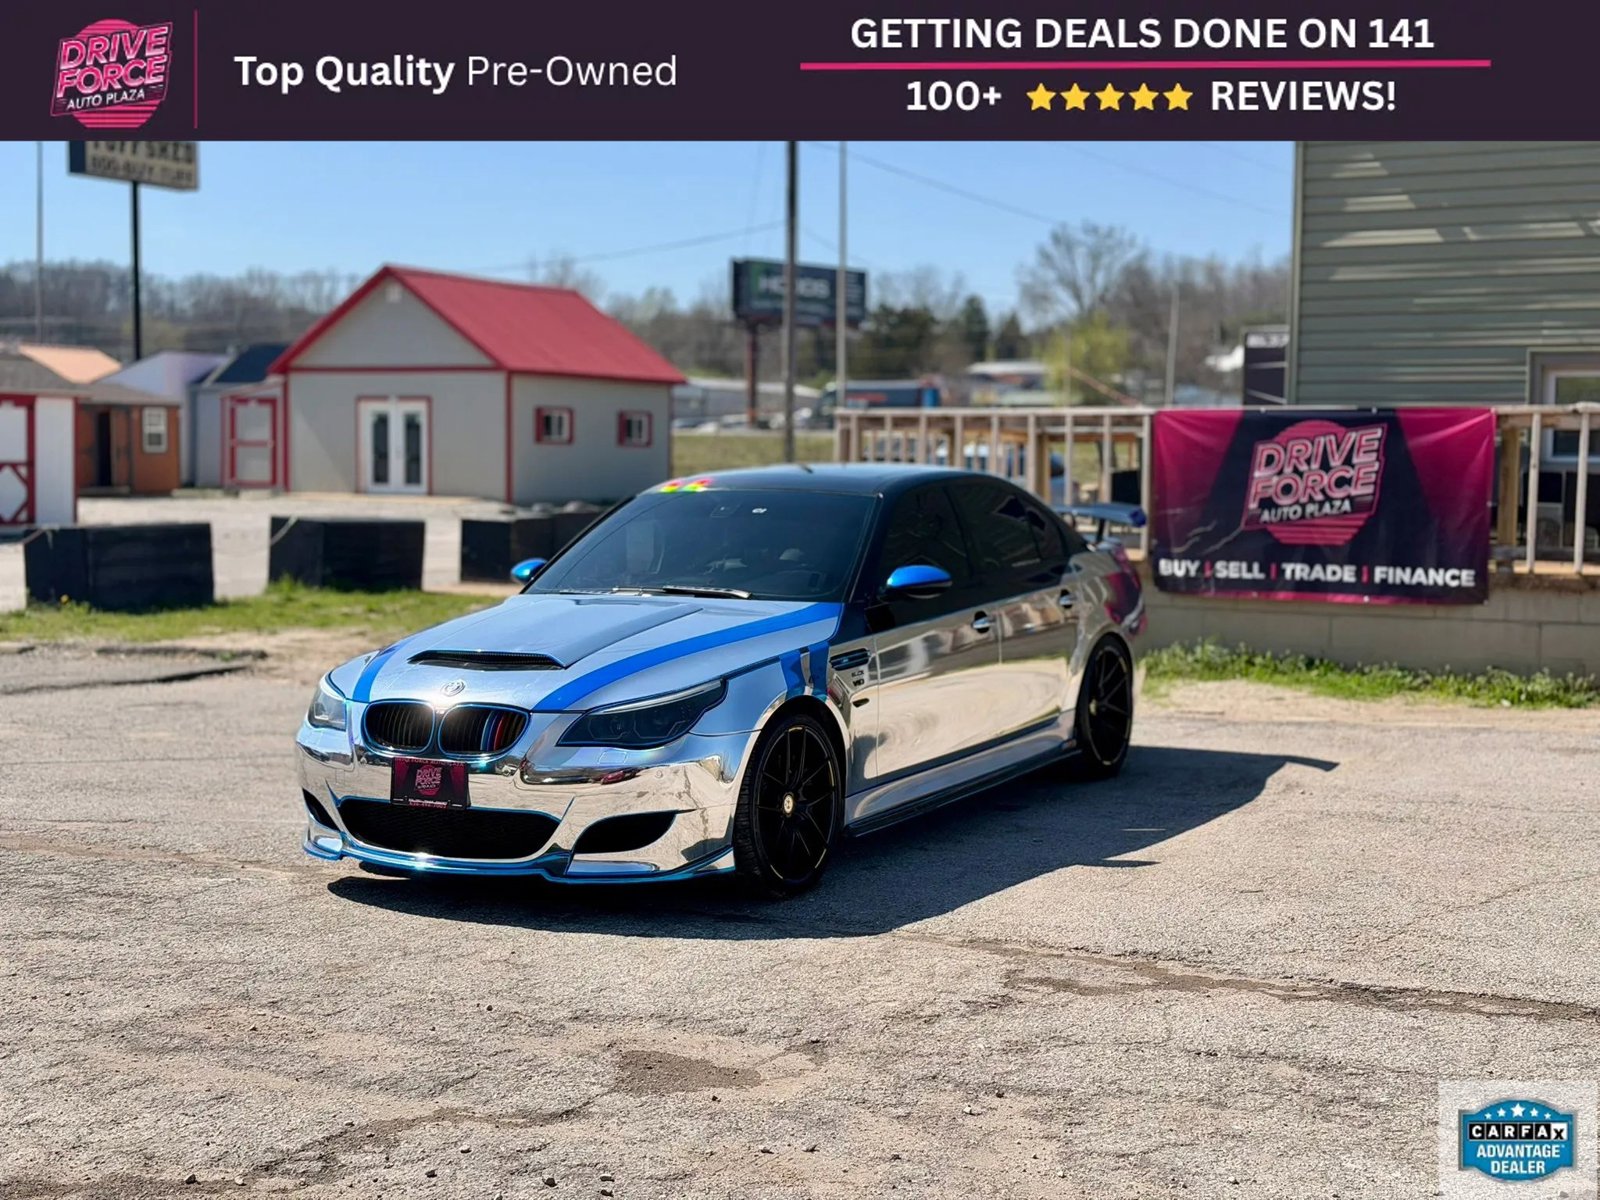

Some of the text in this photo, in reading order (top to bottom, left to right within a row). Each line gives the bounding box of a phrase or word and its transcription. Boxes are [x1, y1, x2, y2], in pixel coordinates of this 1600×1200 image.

[1254, 428, 1382, 478] DRIVE
[1248, 461, 1379, 509] FORCE
[1260, 499, 1351, 522] AUTO PLAZA
[1158, 558, 1476, 587] BUY SELL TRADE FINANCE
